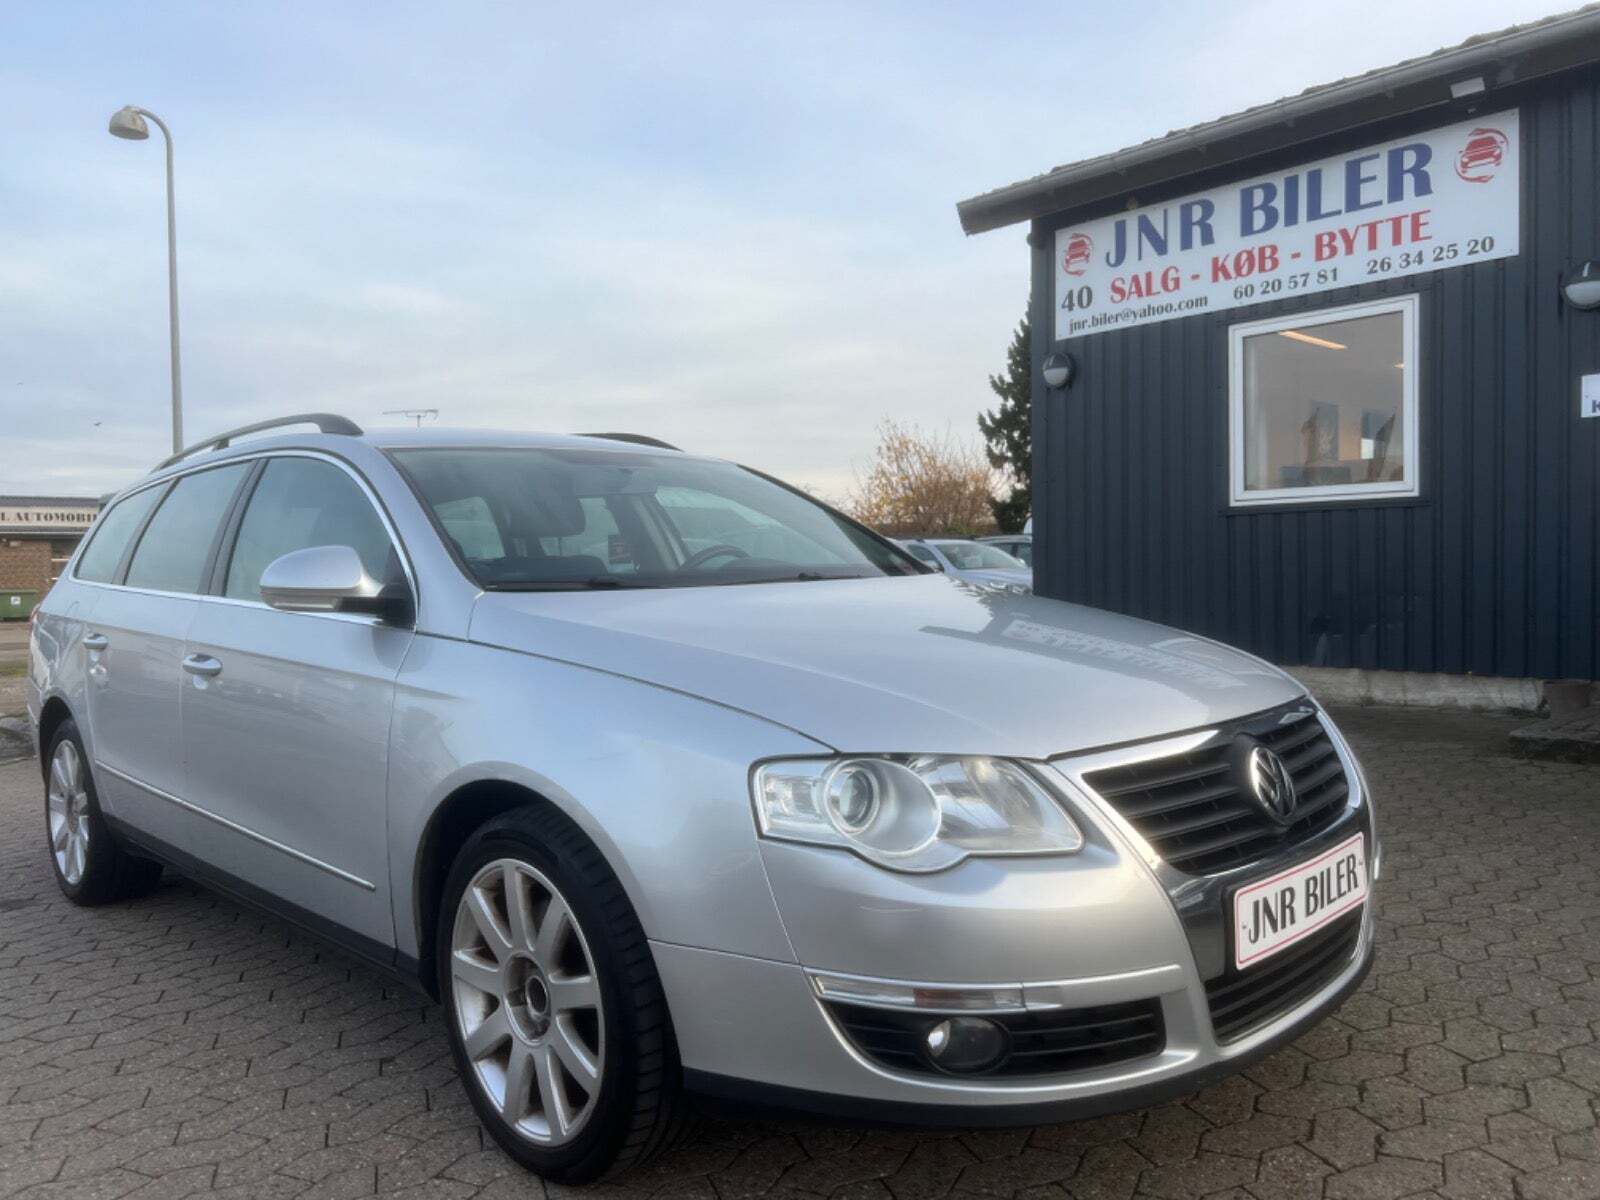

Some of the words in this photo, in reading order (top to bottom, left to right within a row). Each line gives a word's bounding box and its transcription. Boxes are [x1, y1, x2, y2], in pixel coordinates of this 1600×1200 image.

[1105, 198, 1215, 268] JNR
[1239, 143, 1434, 238] BILER
[1110, 265, 1180, 304] SALG
[1211, 244, 1280, 283] KØB
[1314, 209, 1433, 262] BYTTE
[1366, 257, 1392, 275] 26
[1399, 250, 1424, 269] 34
[1432, 243, 1459, 262] 25
[1467, 236, 1495, 256] 20
[1061, 285, 1093, 312] 40
[1233, 283, 1255, 300] 60
[1260, 278, 1282, 295] 20
[1288, 272, 1310, 290] 57
[1316, 267, 1338, 285] 81
[1069, 295, 1209, 334] jnr.biler@yahoo.com
[1249, 886, 1296, 944] JNR
[1304, 853, 1359, 918] BILER
